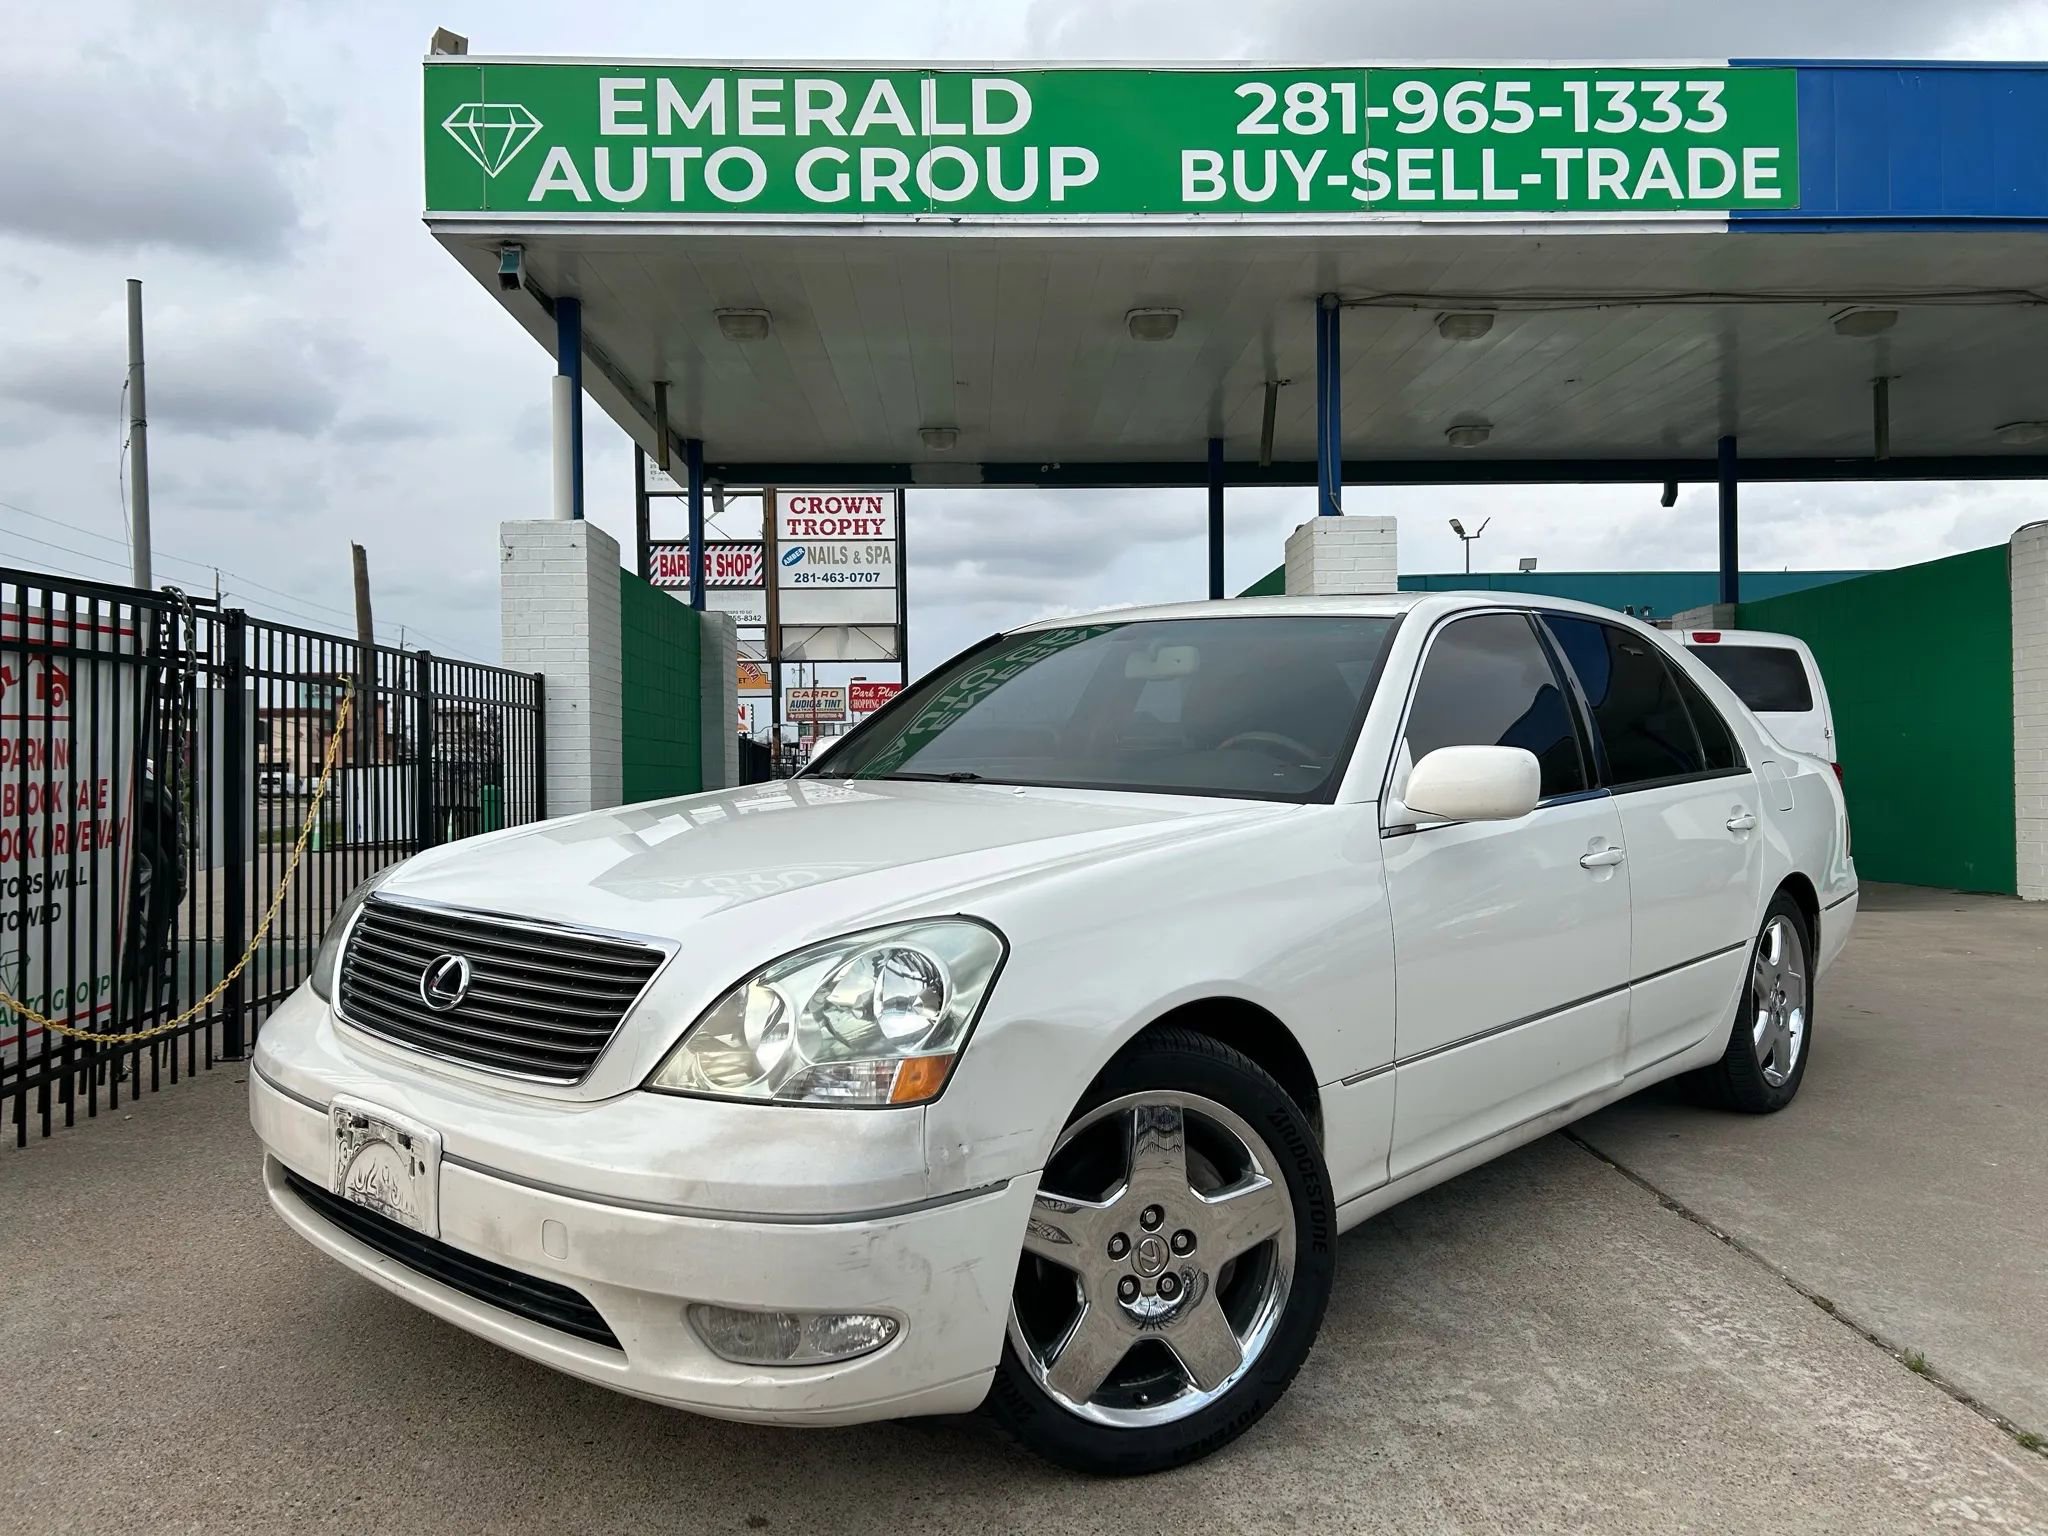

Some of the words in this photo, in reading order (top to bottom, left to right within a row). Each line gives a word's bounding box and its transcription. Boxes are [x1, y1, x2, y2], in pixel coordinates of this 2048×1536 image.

[599, 77, 1033, 137] EMERALD
[1233, 80, 1728, 135] 281-965-1333
[527, 145, 767, 204] AUTO
[794, 145, 1100, 204] GROUP
[1180, 146, 1782, 202] BUY-SELL-TRADE
[789, 496, 883, 514] CROWN
[786, 518, 886, 536] TROPHY
[660, 553, 712, 578] BARR
[716, 553, 753, 578] SHOP
[783, 547, 805, 566] AMBER
[807, 545, 848, 565] NAILS
[853, 550, 862, 565] &
[865, 545, 892, 565] SPA
[794, 572, 881, 583] 281-463-0707
[789, 699, 815, 709] AUDIO
[824, 699, 842, 708] TINT
[792, 690, 839, 698] CARRO
[851, 686, 875, 698] Park
[0, 737, 70, 772] PARKN
[51, 866, 88, 891] WIL
[53, 974, 111, 1011] GOP
[1266, 1106, 1329, 1255] BRIDGESTONE
